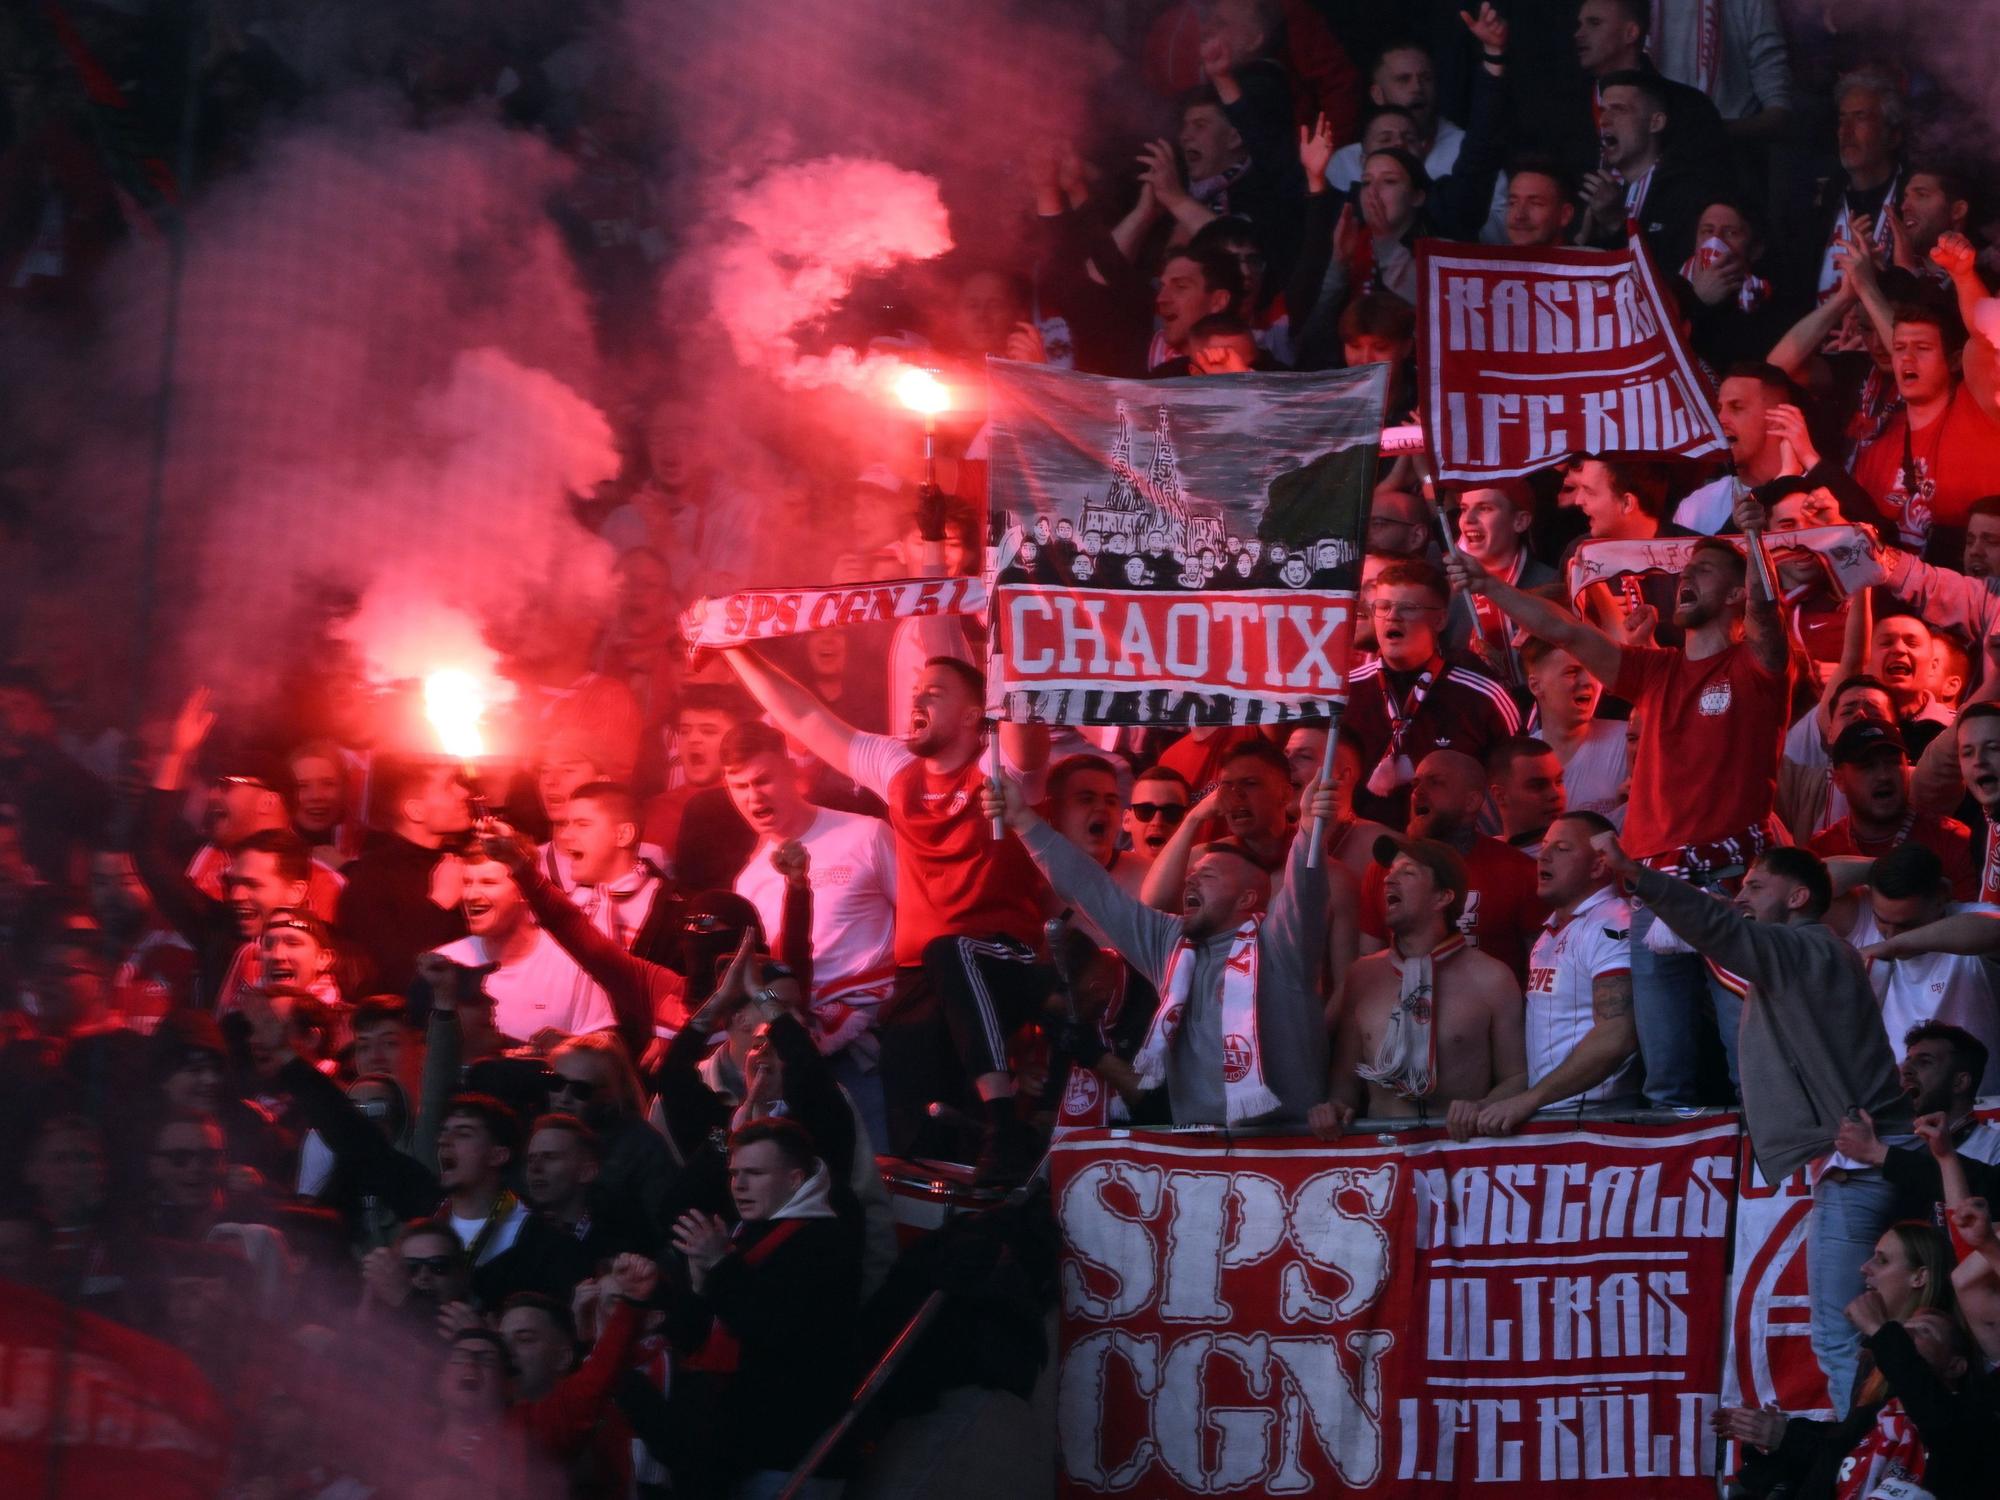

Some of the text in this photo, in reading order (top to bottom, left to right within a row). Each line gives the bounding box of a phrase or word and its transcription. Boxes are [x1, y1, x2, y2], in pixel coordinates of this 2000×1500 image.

[724, 593, 803, 637] SPS
[809, 586, 906, 629] CGN
[1011, 595, 1347, 688] CHAOTIX
[1058, 1159, 1398, 1323] SPS
[1412, 1156, 1735, 1250] RASCALS
[1427, 1271, 1689, 1361] ULTRAS
[1056, 1329, 1395, 1495] CGN
[1537, 1386, 1719, 1480] KÖLN
